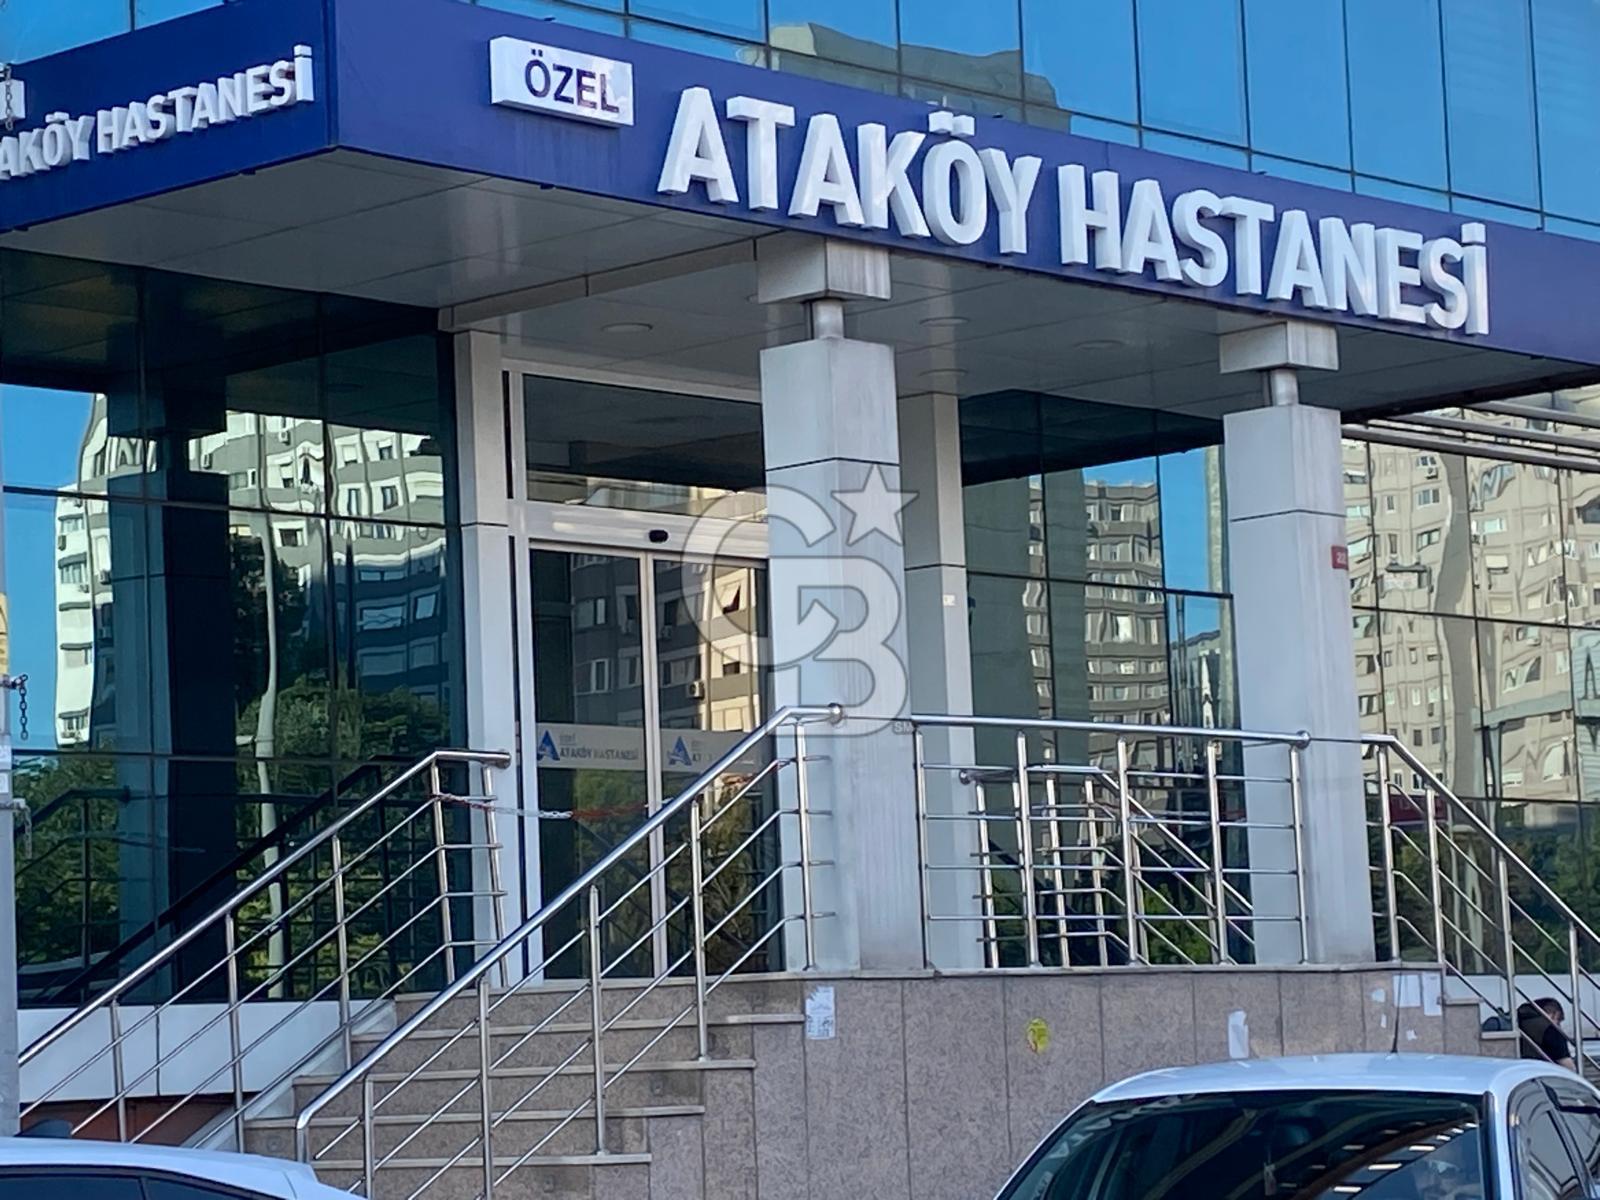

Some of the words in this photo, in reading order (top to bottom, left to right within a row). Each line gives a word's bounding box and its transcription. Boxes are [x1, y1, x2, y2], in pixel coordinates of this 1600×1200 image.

[97, 44, 315, 154] HASTANESİ
[524, 48, 620, 114] ÖZEL
[656, 86, 1043, 255] ATAKÖY
[1057, 163, 1489, 335] HASTANESİ
